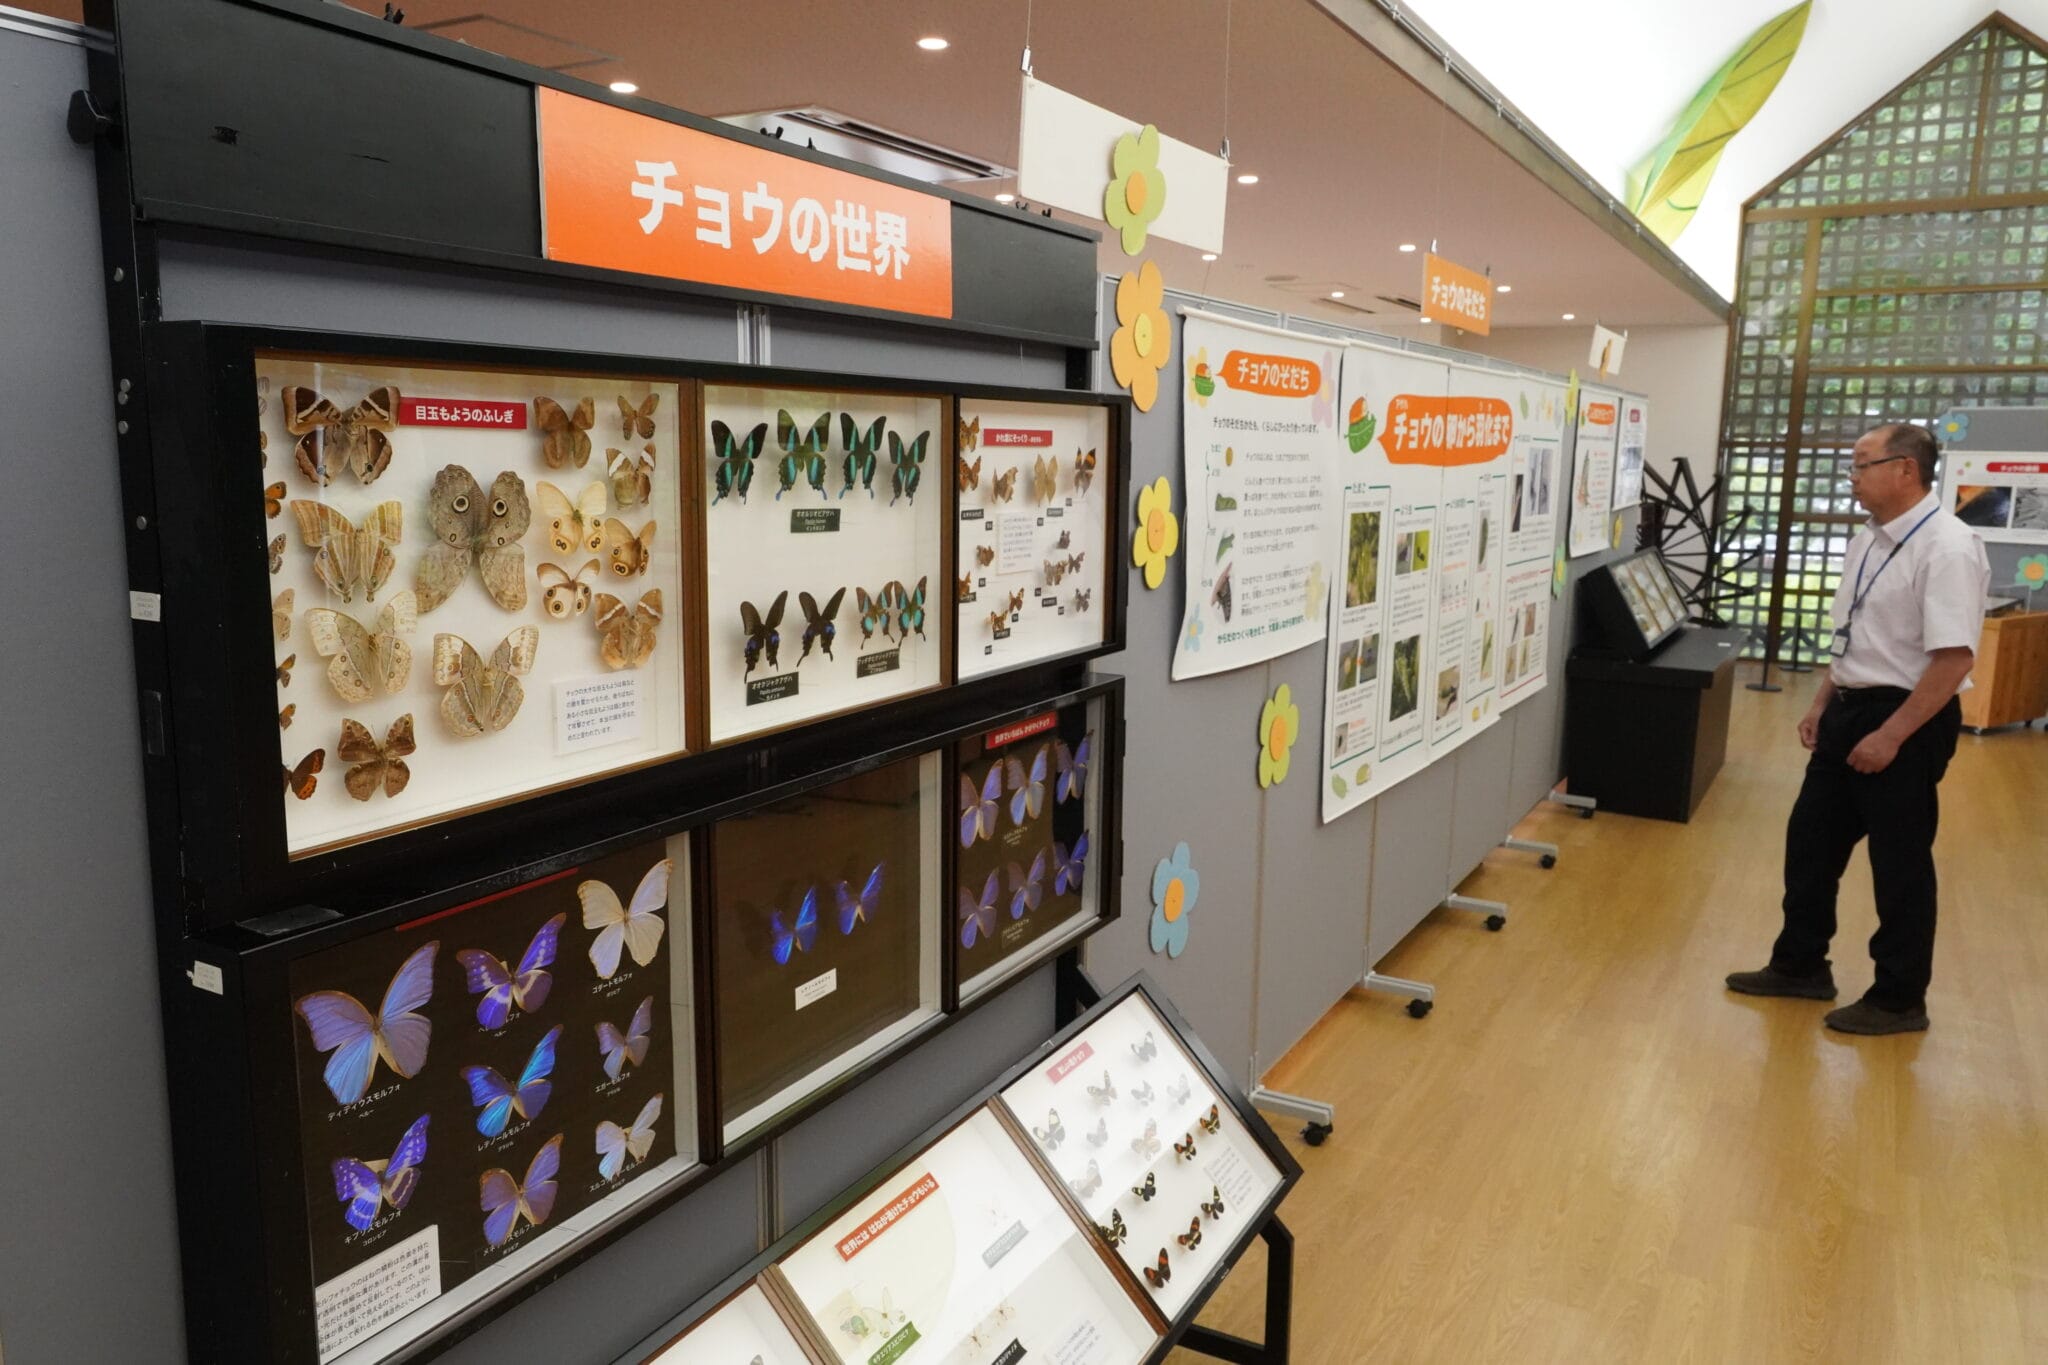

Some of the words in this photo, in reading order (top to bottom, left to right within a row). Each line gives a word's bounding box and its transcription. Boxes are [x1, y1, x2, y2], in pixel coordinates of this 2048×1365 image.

[630, 159, 911, 280] チョウの世界
[1431, 276, 1487, 321] チョウのそだち
[1237, 358, 1310, 391] チョウのそだち
[415, 405, 514, 424] 目玉もようのふしぎ
[1394, 411, 1510, 451] チョウの卵から羽化まで
[328, 1084, 400, 1121] ディディウスモルフォ
